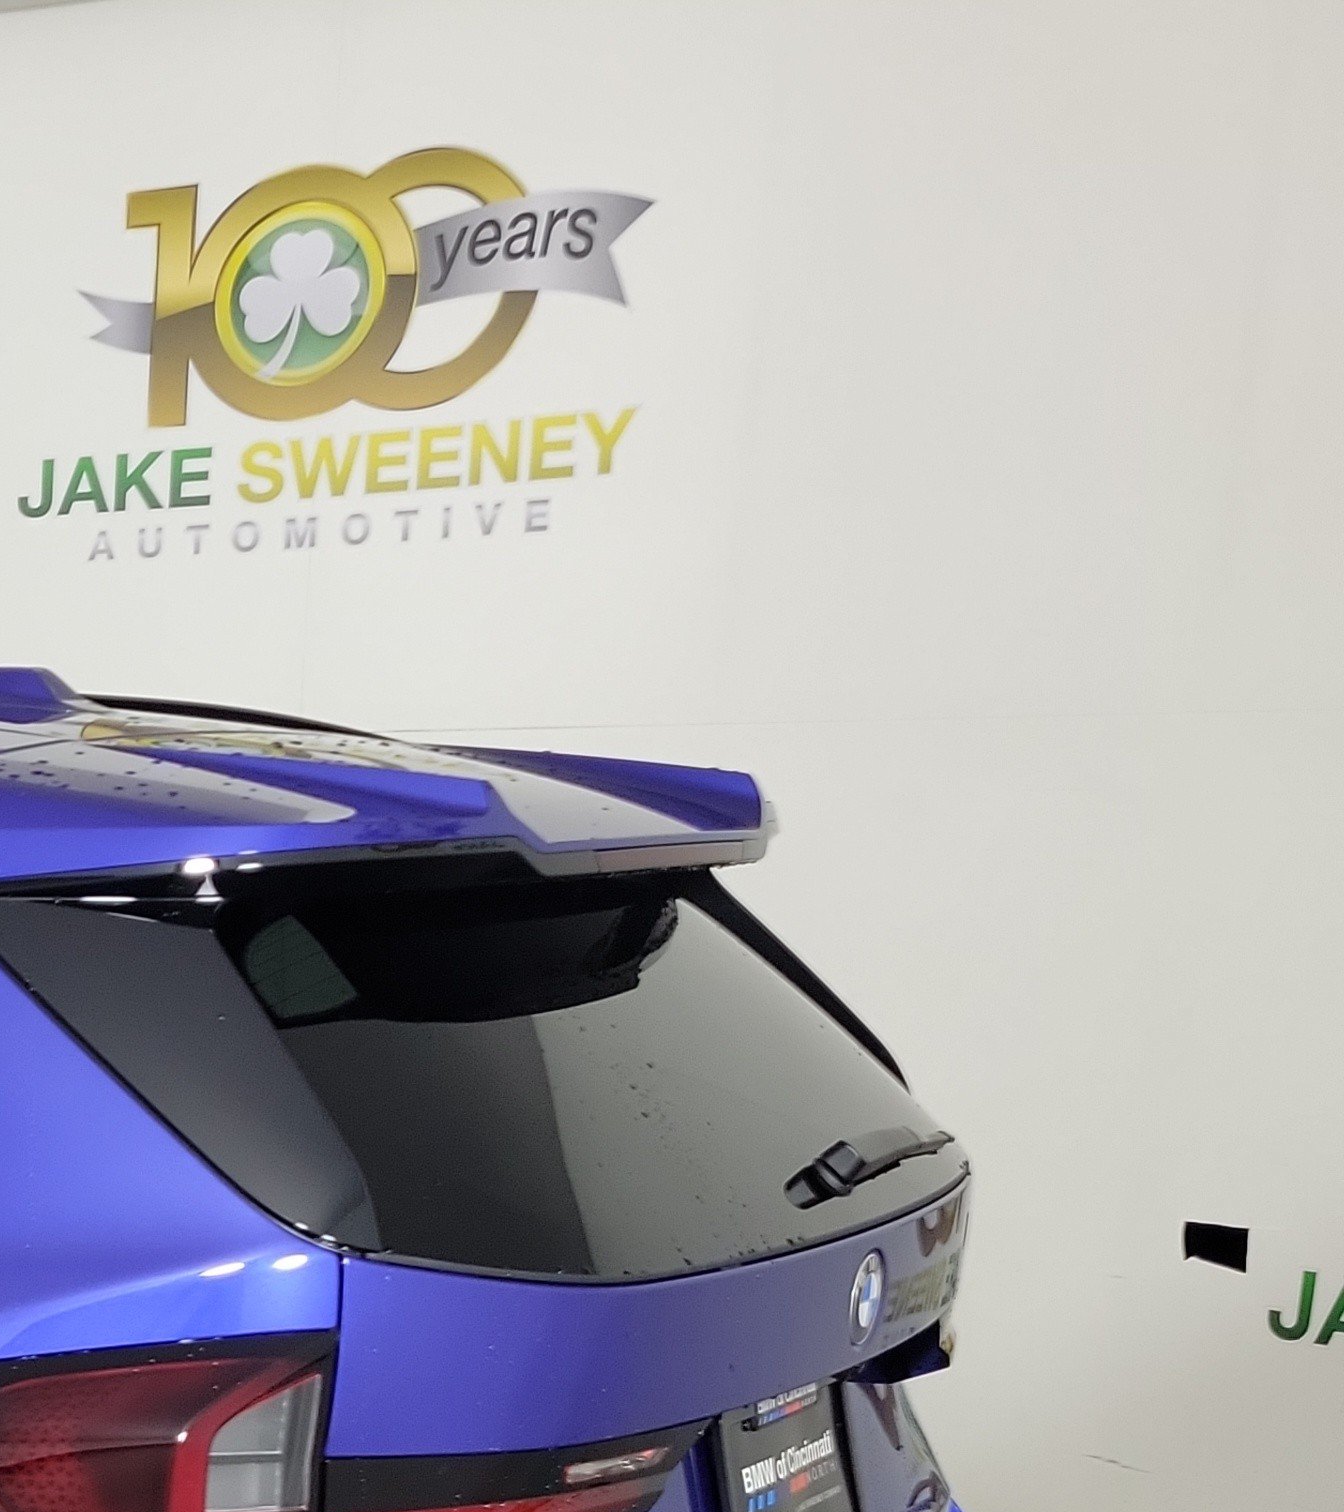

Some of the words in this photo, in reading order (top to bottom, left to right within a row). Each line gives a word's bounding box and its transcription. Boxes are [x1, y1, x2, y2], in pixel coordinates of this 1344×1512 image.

[429, 202, 599, 292] years
[16, 446, 213, 520] JAKE
[236, 404, 643, 504] SWEENEY
[88, 500, 551, 561] AUTOMOTIVE
[741, 1457, 777, 1493] BMW
[777, 1451, 788, 1479] of
[787, 1430, 833, 1473] Cincinnati
